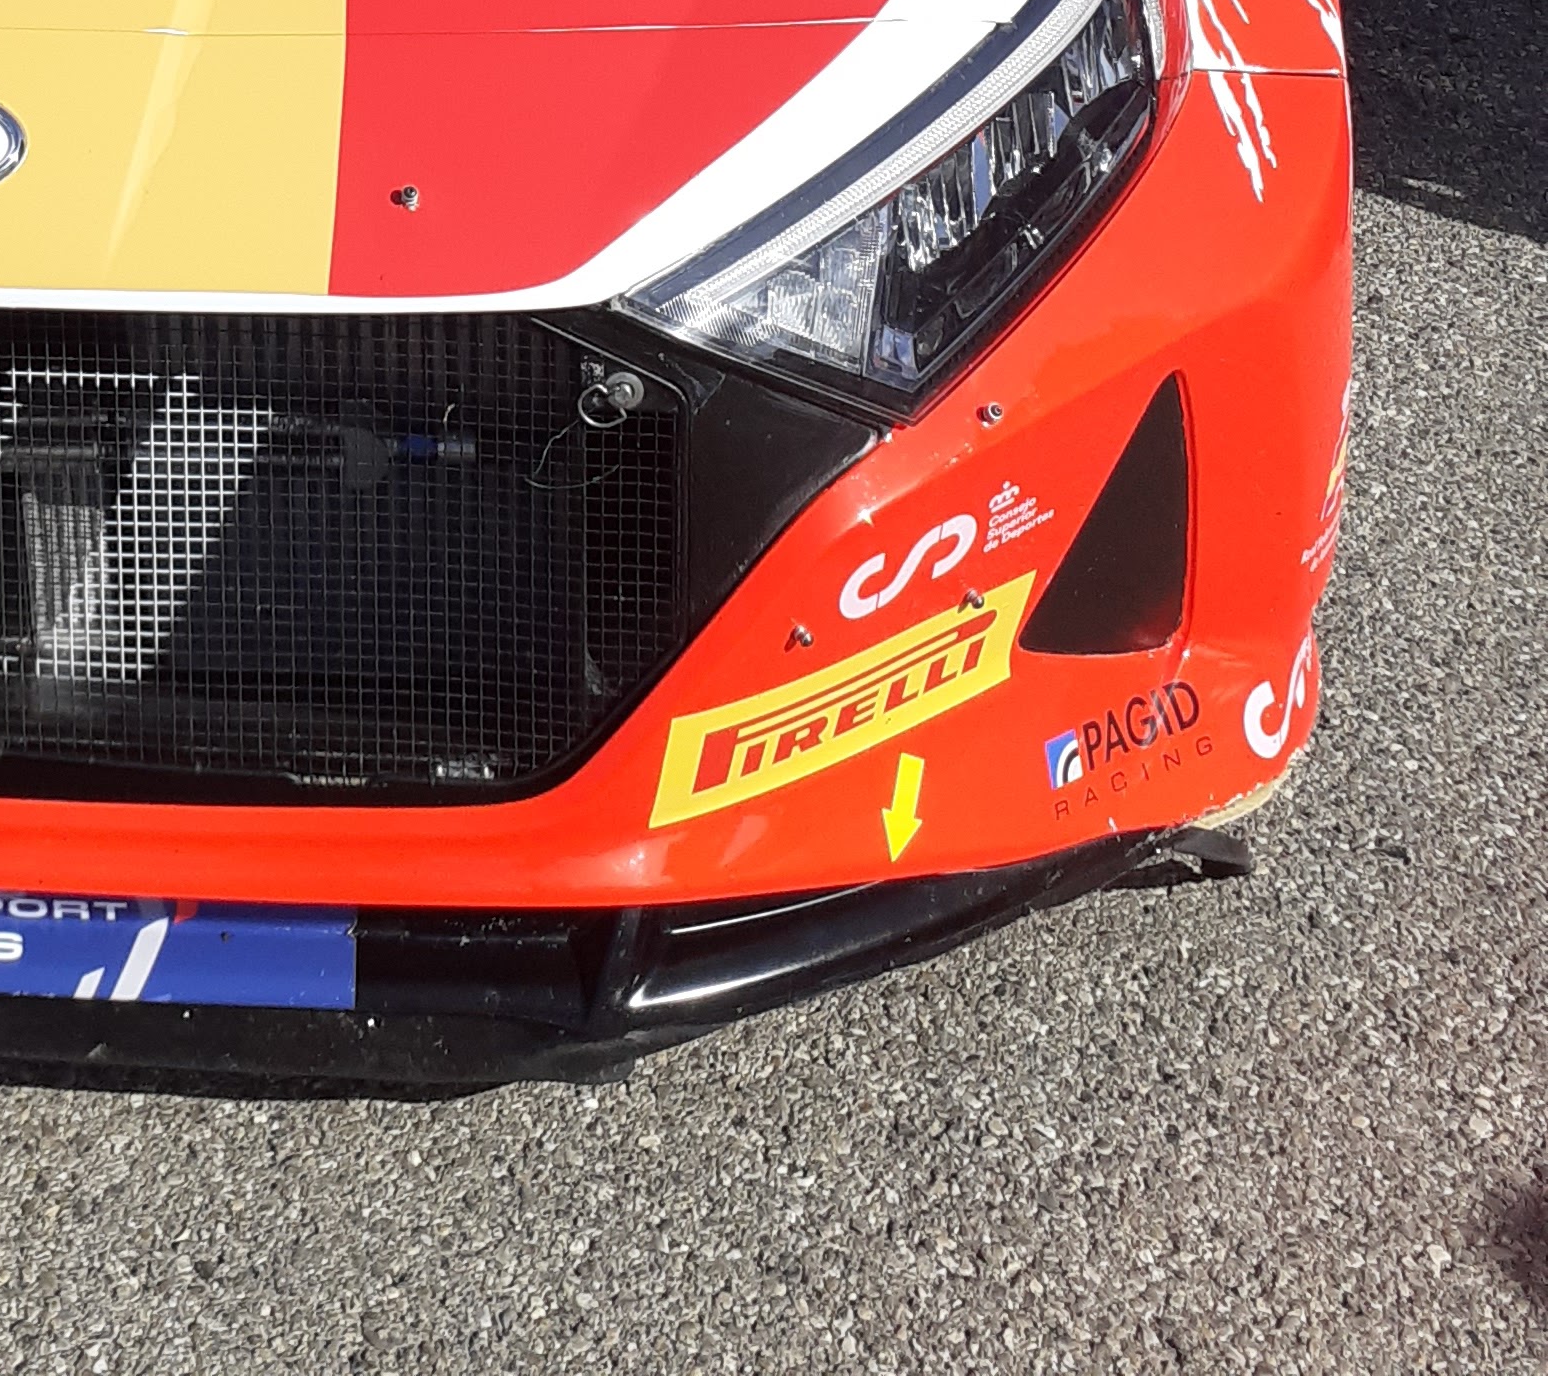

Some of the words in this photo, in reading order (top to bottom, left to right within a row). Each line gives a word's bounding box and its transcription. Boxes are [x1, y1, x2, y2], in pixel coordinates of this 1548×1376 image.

[982, 538, 1000, 553] de
[1000, 508, 1056, 545] Deportes
[986, 506, 1039, 541] Superior
[988, 496, 1037, 528] Consejo
[692, 608, 998, 796] PIRELLI
[1082, 679, 1201, 773] PAGID
[1053, 735, 1214, 822] RACING
